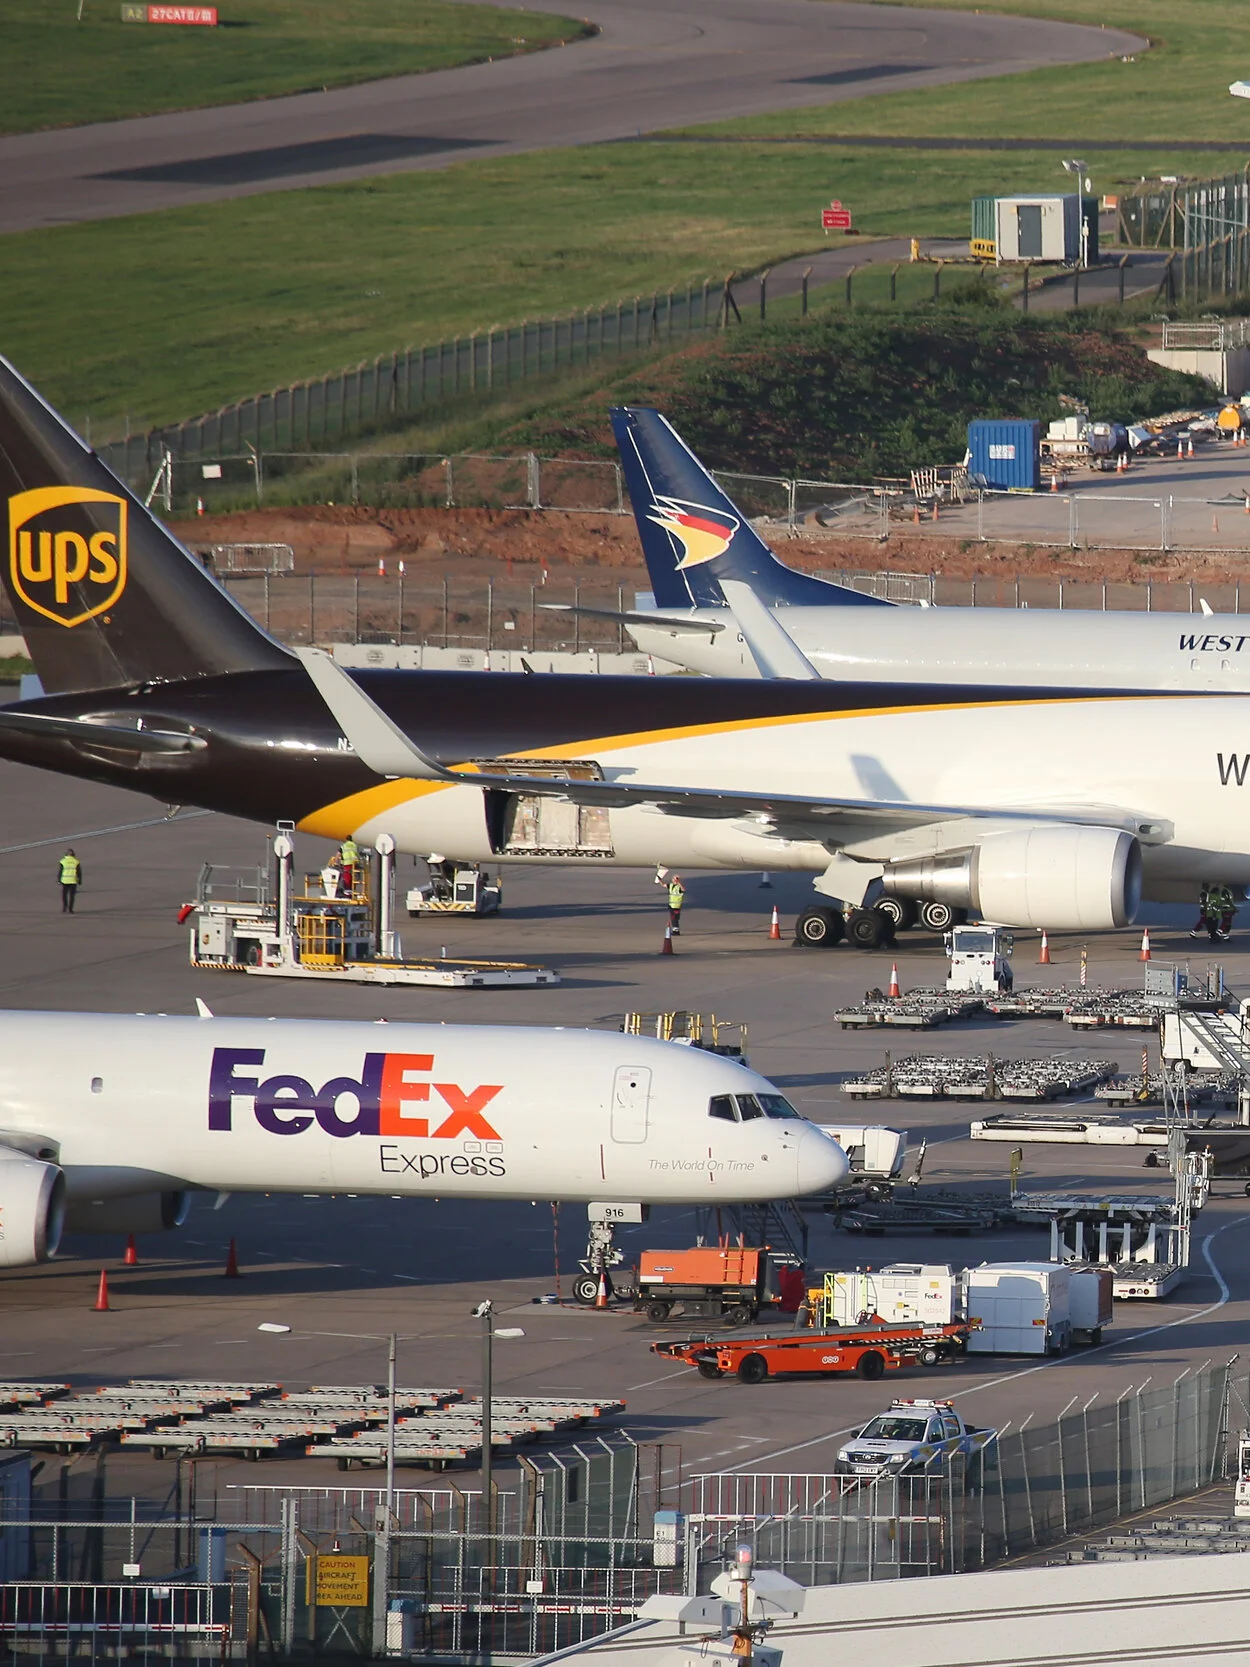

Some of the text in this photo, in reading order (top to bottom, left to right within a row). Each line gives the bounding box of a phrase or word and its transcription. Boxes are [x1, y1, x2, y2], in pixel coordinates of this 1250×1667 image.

[208, 1047, 505, 1141] FedEx
[380, 1145, 506, 1179] Express
[649, 1159, 755, 1171] The World On Time
[605, 1208, 624, 1218] 916
